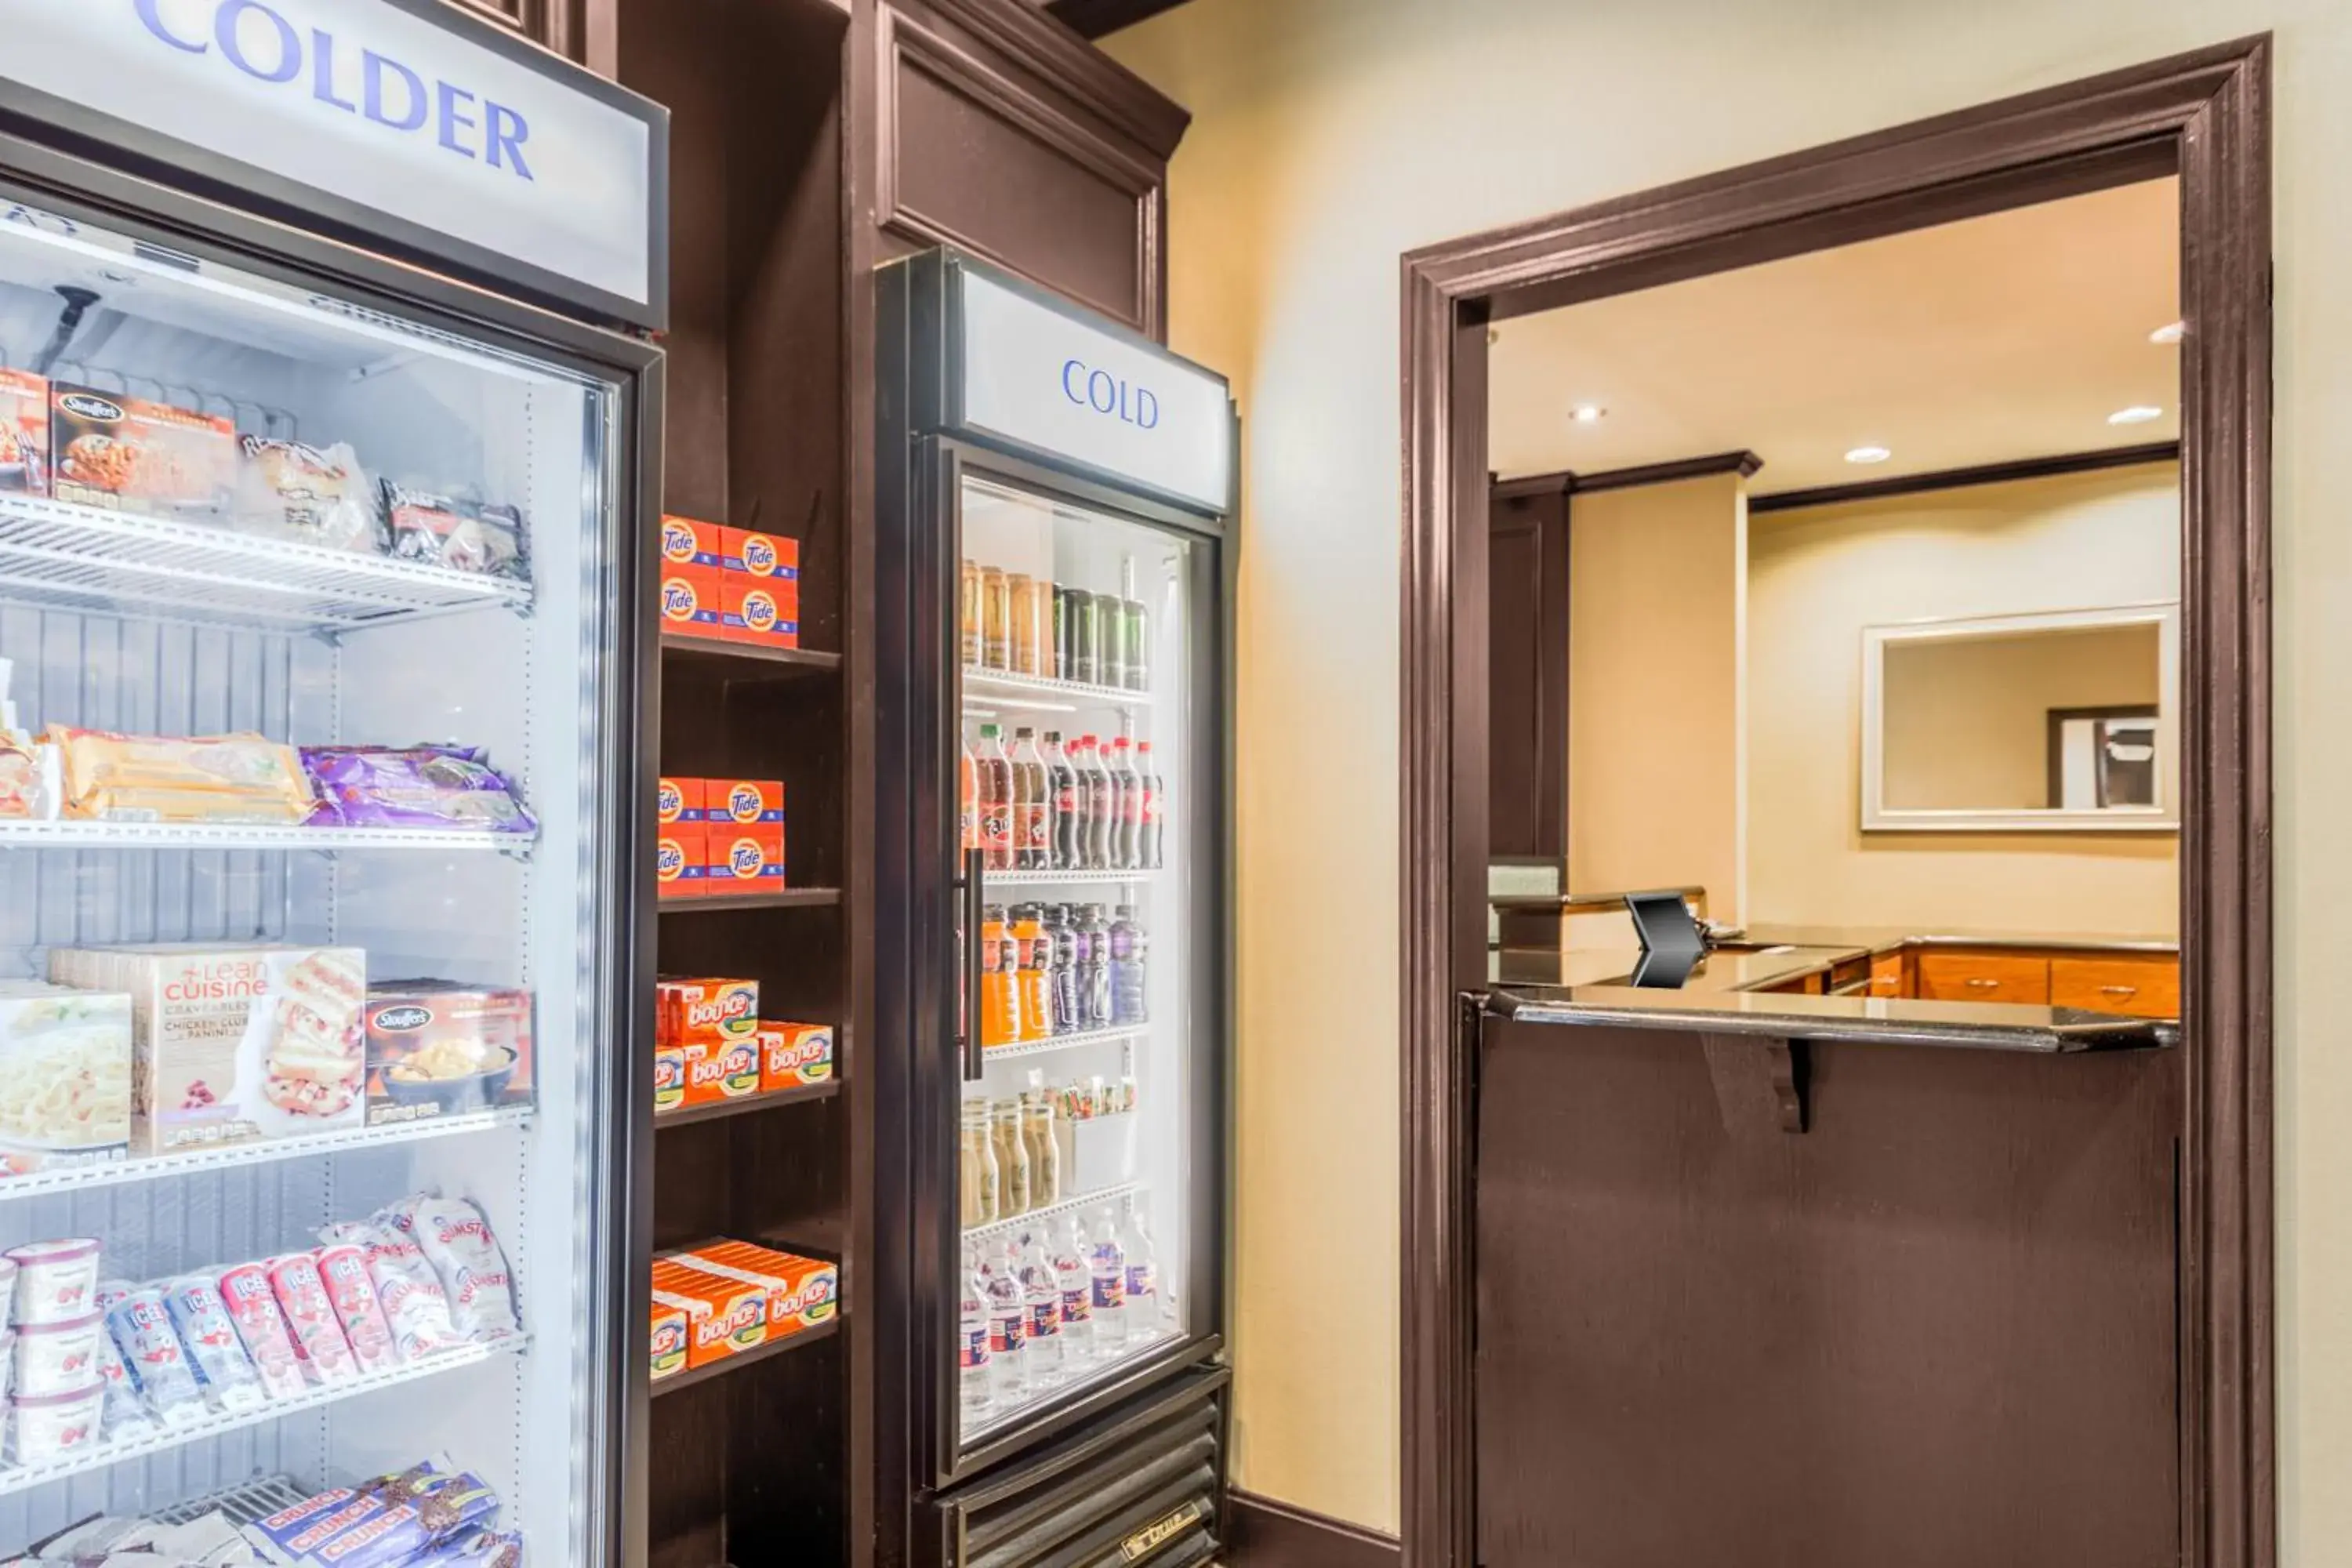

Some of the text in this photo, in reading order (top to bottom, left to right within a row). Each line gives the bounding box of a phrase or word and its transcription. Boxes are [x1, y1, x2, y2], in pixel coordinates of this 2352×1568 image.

[132, 0, 535, 182] COLDER
[1062, 359, 1159, 429] COLD
[665, 530, 693, 550] Tide
[746, 546, 773, 565] Tide
[665, 589, 693, 610] Tide
[746, 601, 773, 622] Tide
[659, 791, 680, 810] ide
[732, 793, 759, 815] Tide
[733, 848, 760, 870] Tide
[267, 1489, 347, 1527] CRUNCH
[292, 1497, 377, 1548] CRUNCH
[325, 1504, 416, 1557] CRUNCH
